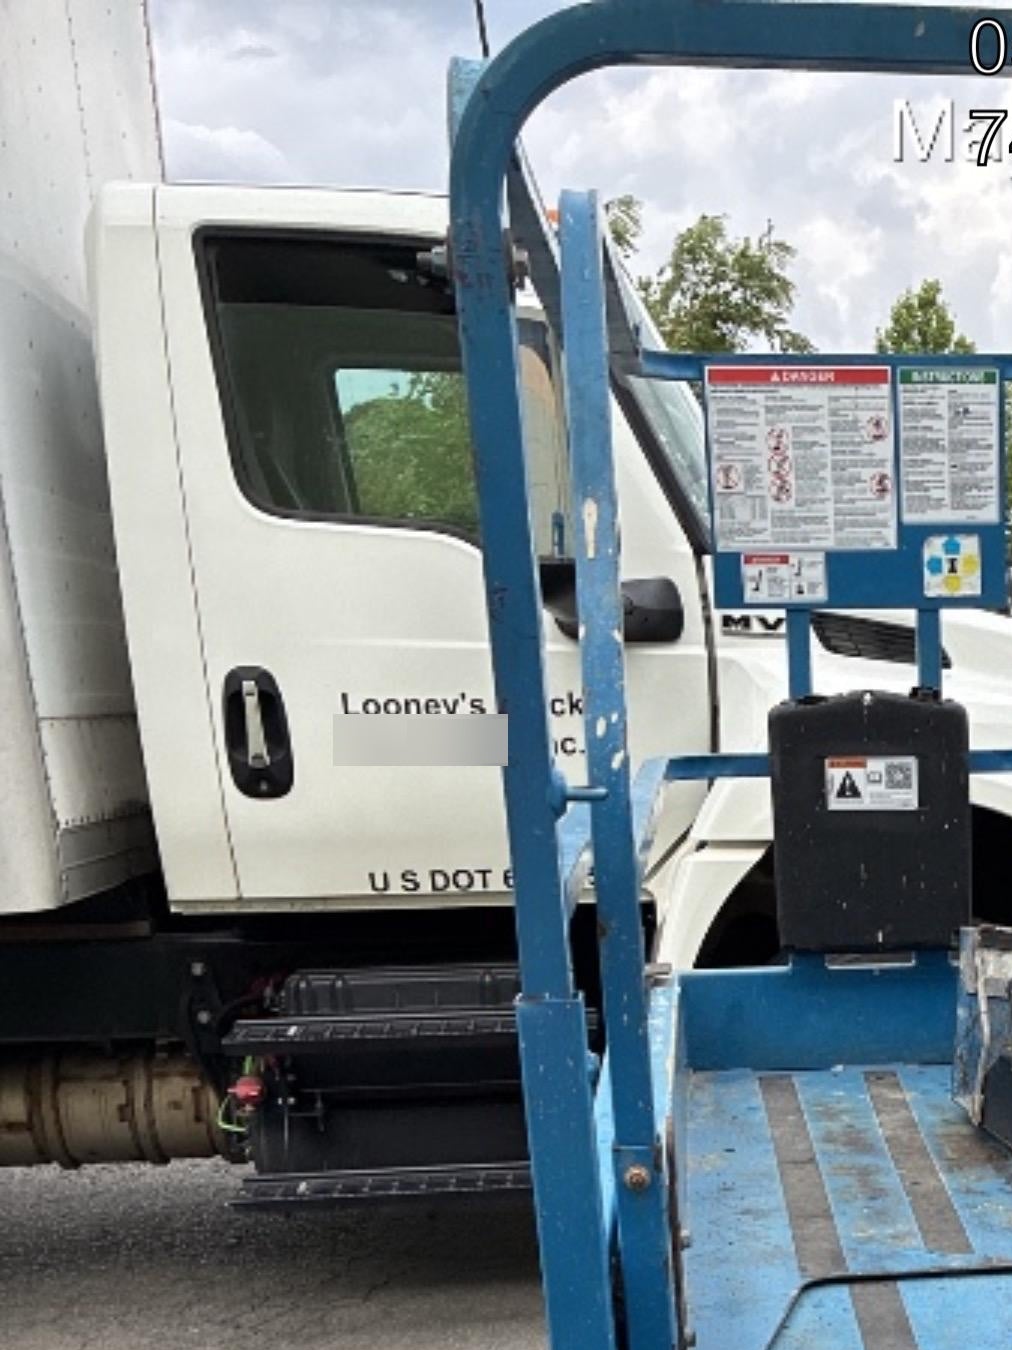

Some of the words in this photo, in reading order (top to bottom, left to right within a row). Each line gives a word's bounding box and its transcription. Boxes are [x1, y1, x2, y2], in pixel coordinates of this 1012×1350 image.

[722, 614, 787, 631] MV
[341, 692, 487, 715] Looney's
[429, 868, 493, 892] DOT
